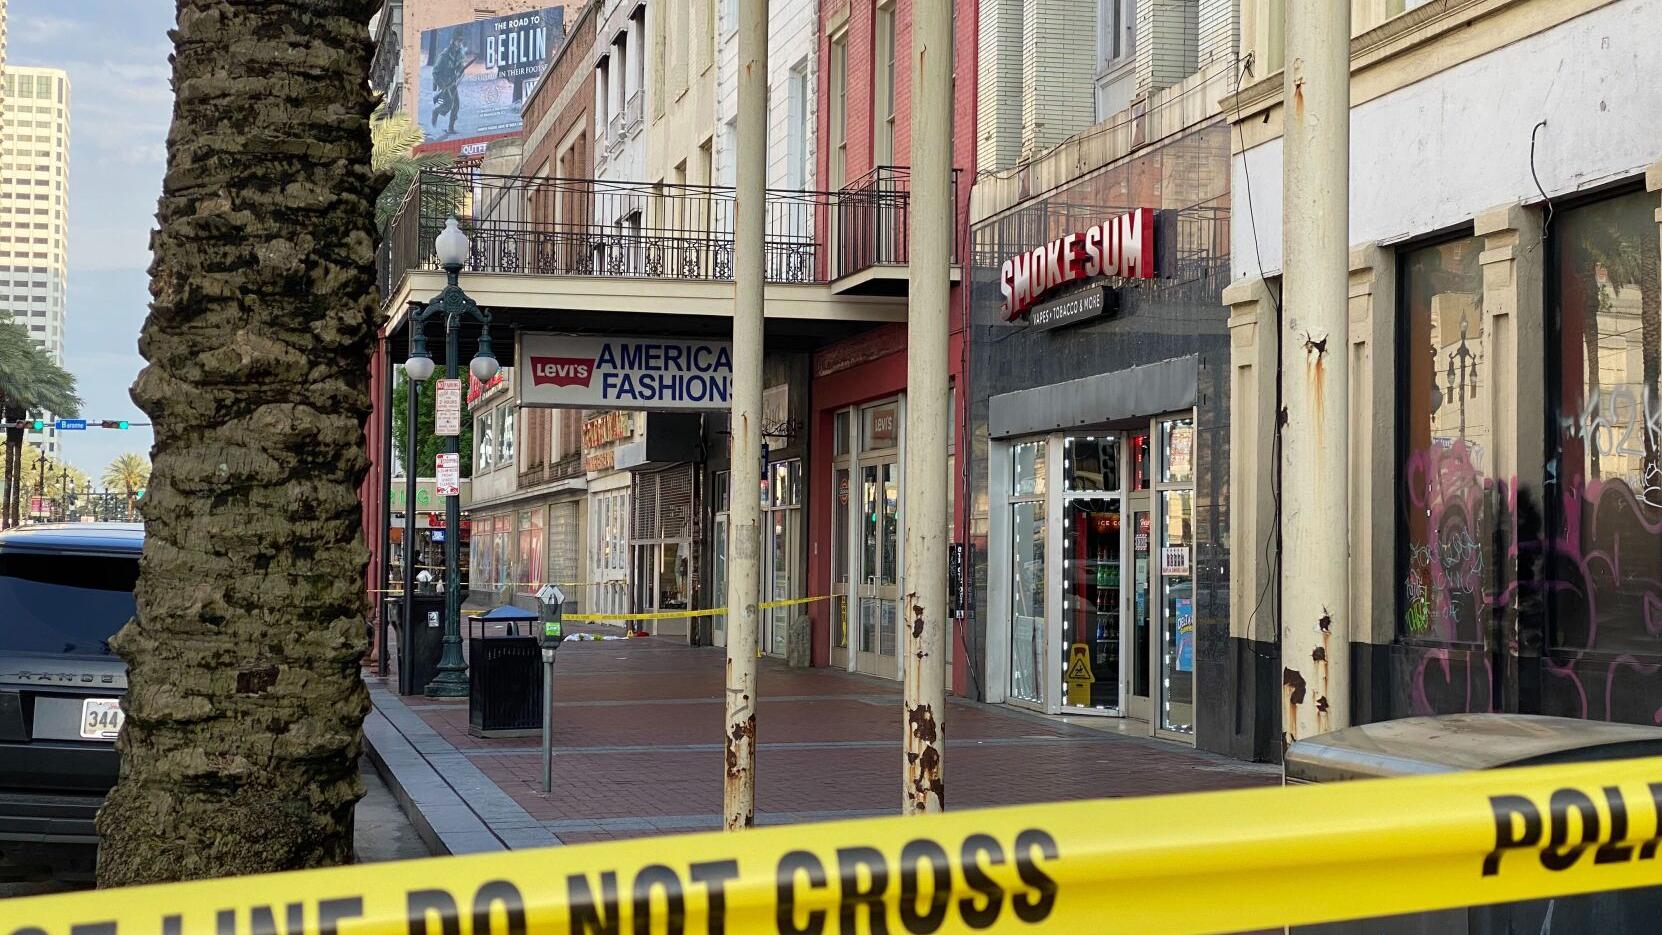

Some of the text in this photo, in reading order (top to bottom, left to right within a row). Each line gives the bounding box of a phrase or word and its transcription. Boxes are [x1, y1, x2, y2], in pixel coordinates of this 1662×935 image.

[495, 16, 540, 31] THE ROAD TO
[486, 27, 546, 69] BERLIN
[507, 68, 525, 77] THEIR
[1001, 207, 1143, 321] SMOKE SUM
[1033, 294, 1100, 326] VAPES TOBACCO & MORE
[596, 343, 733, 373] AMERICA
[602, 372, 733, 402] FASHION
[19, 671, 113, 683] RANGE
[88, 711, 118, 728] 344
[566, 859, 739, 935] NOT
[776, 828, 1059, 935] CROSS
